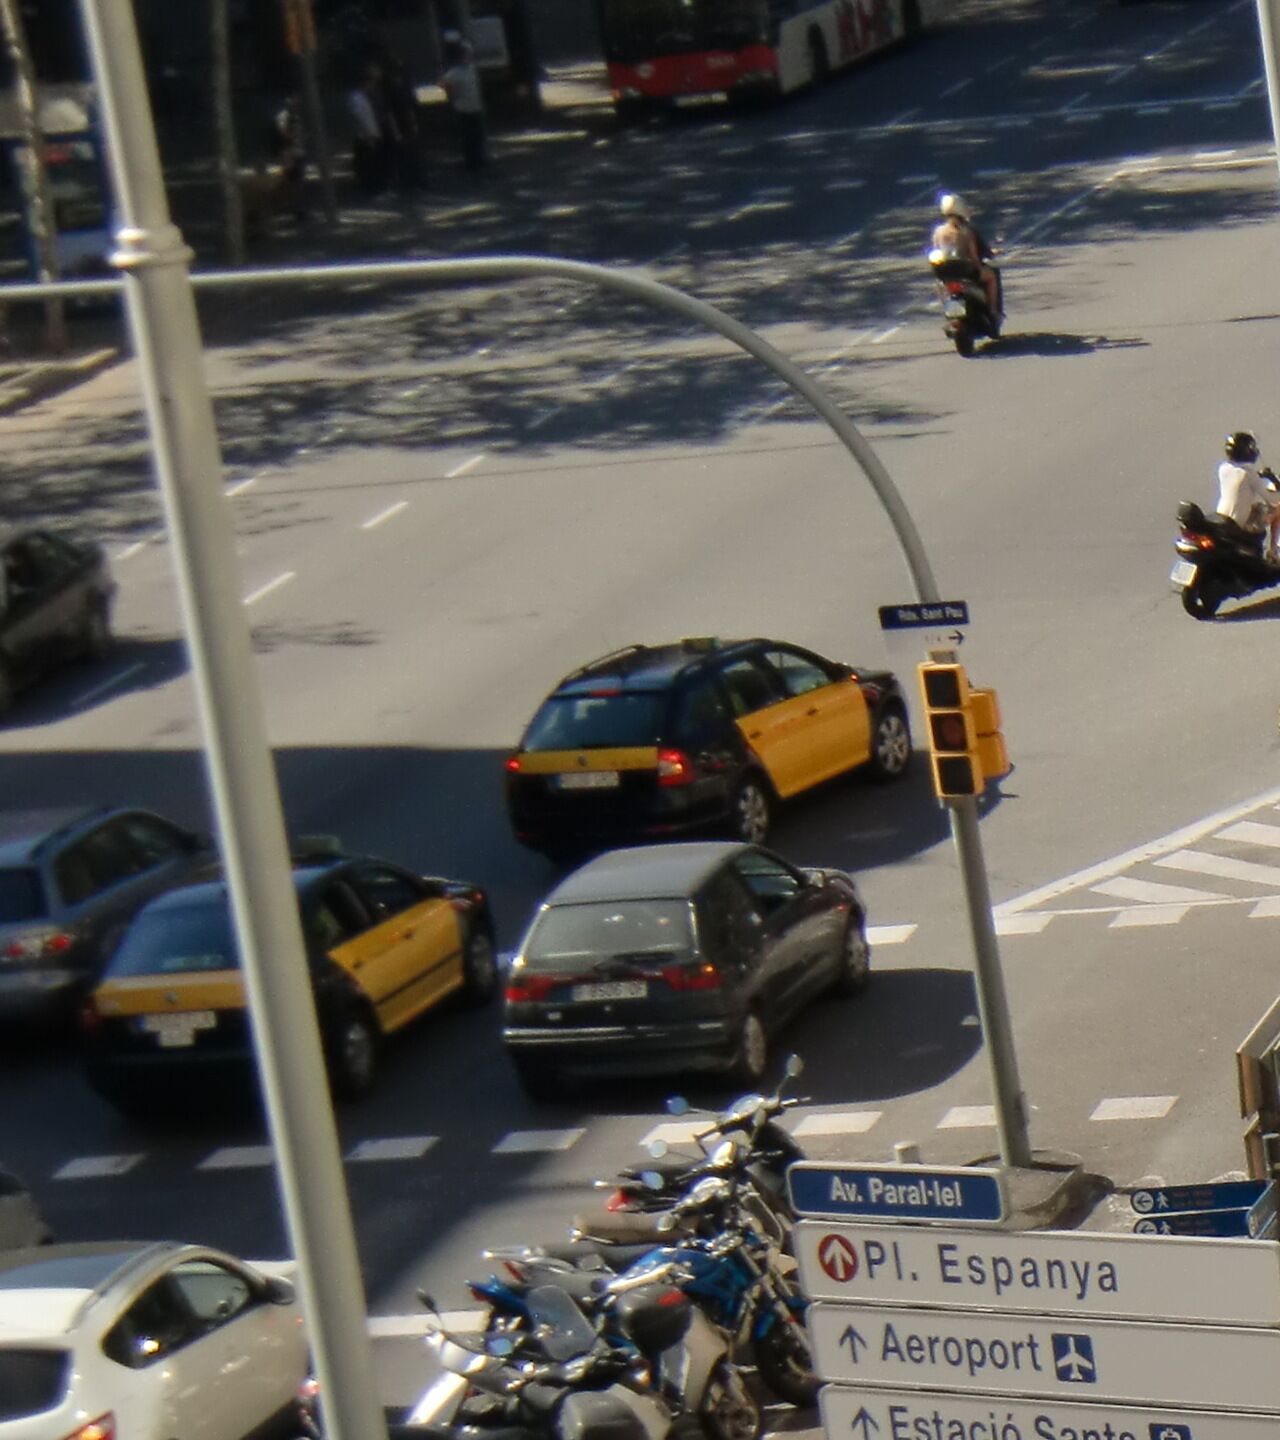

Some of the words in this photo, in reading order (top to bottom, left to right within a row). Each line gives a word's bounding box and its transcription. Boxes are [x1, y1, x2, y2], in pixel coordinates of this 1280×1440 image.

[830, 1176, 863, 1203] Av.
[869, 1178, 963, 1208] Paral·lel
[864, 1239, 919, 1282] Pl.
[937, 1243, 1120, 1301] Espanya
[881, 1322, 1043, 1377] Aeroport
